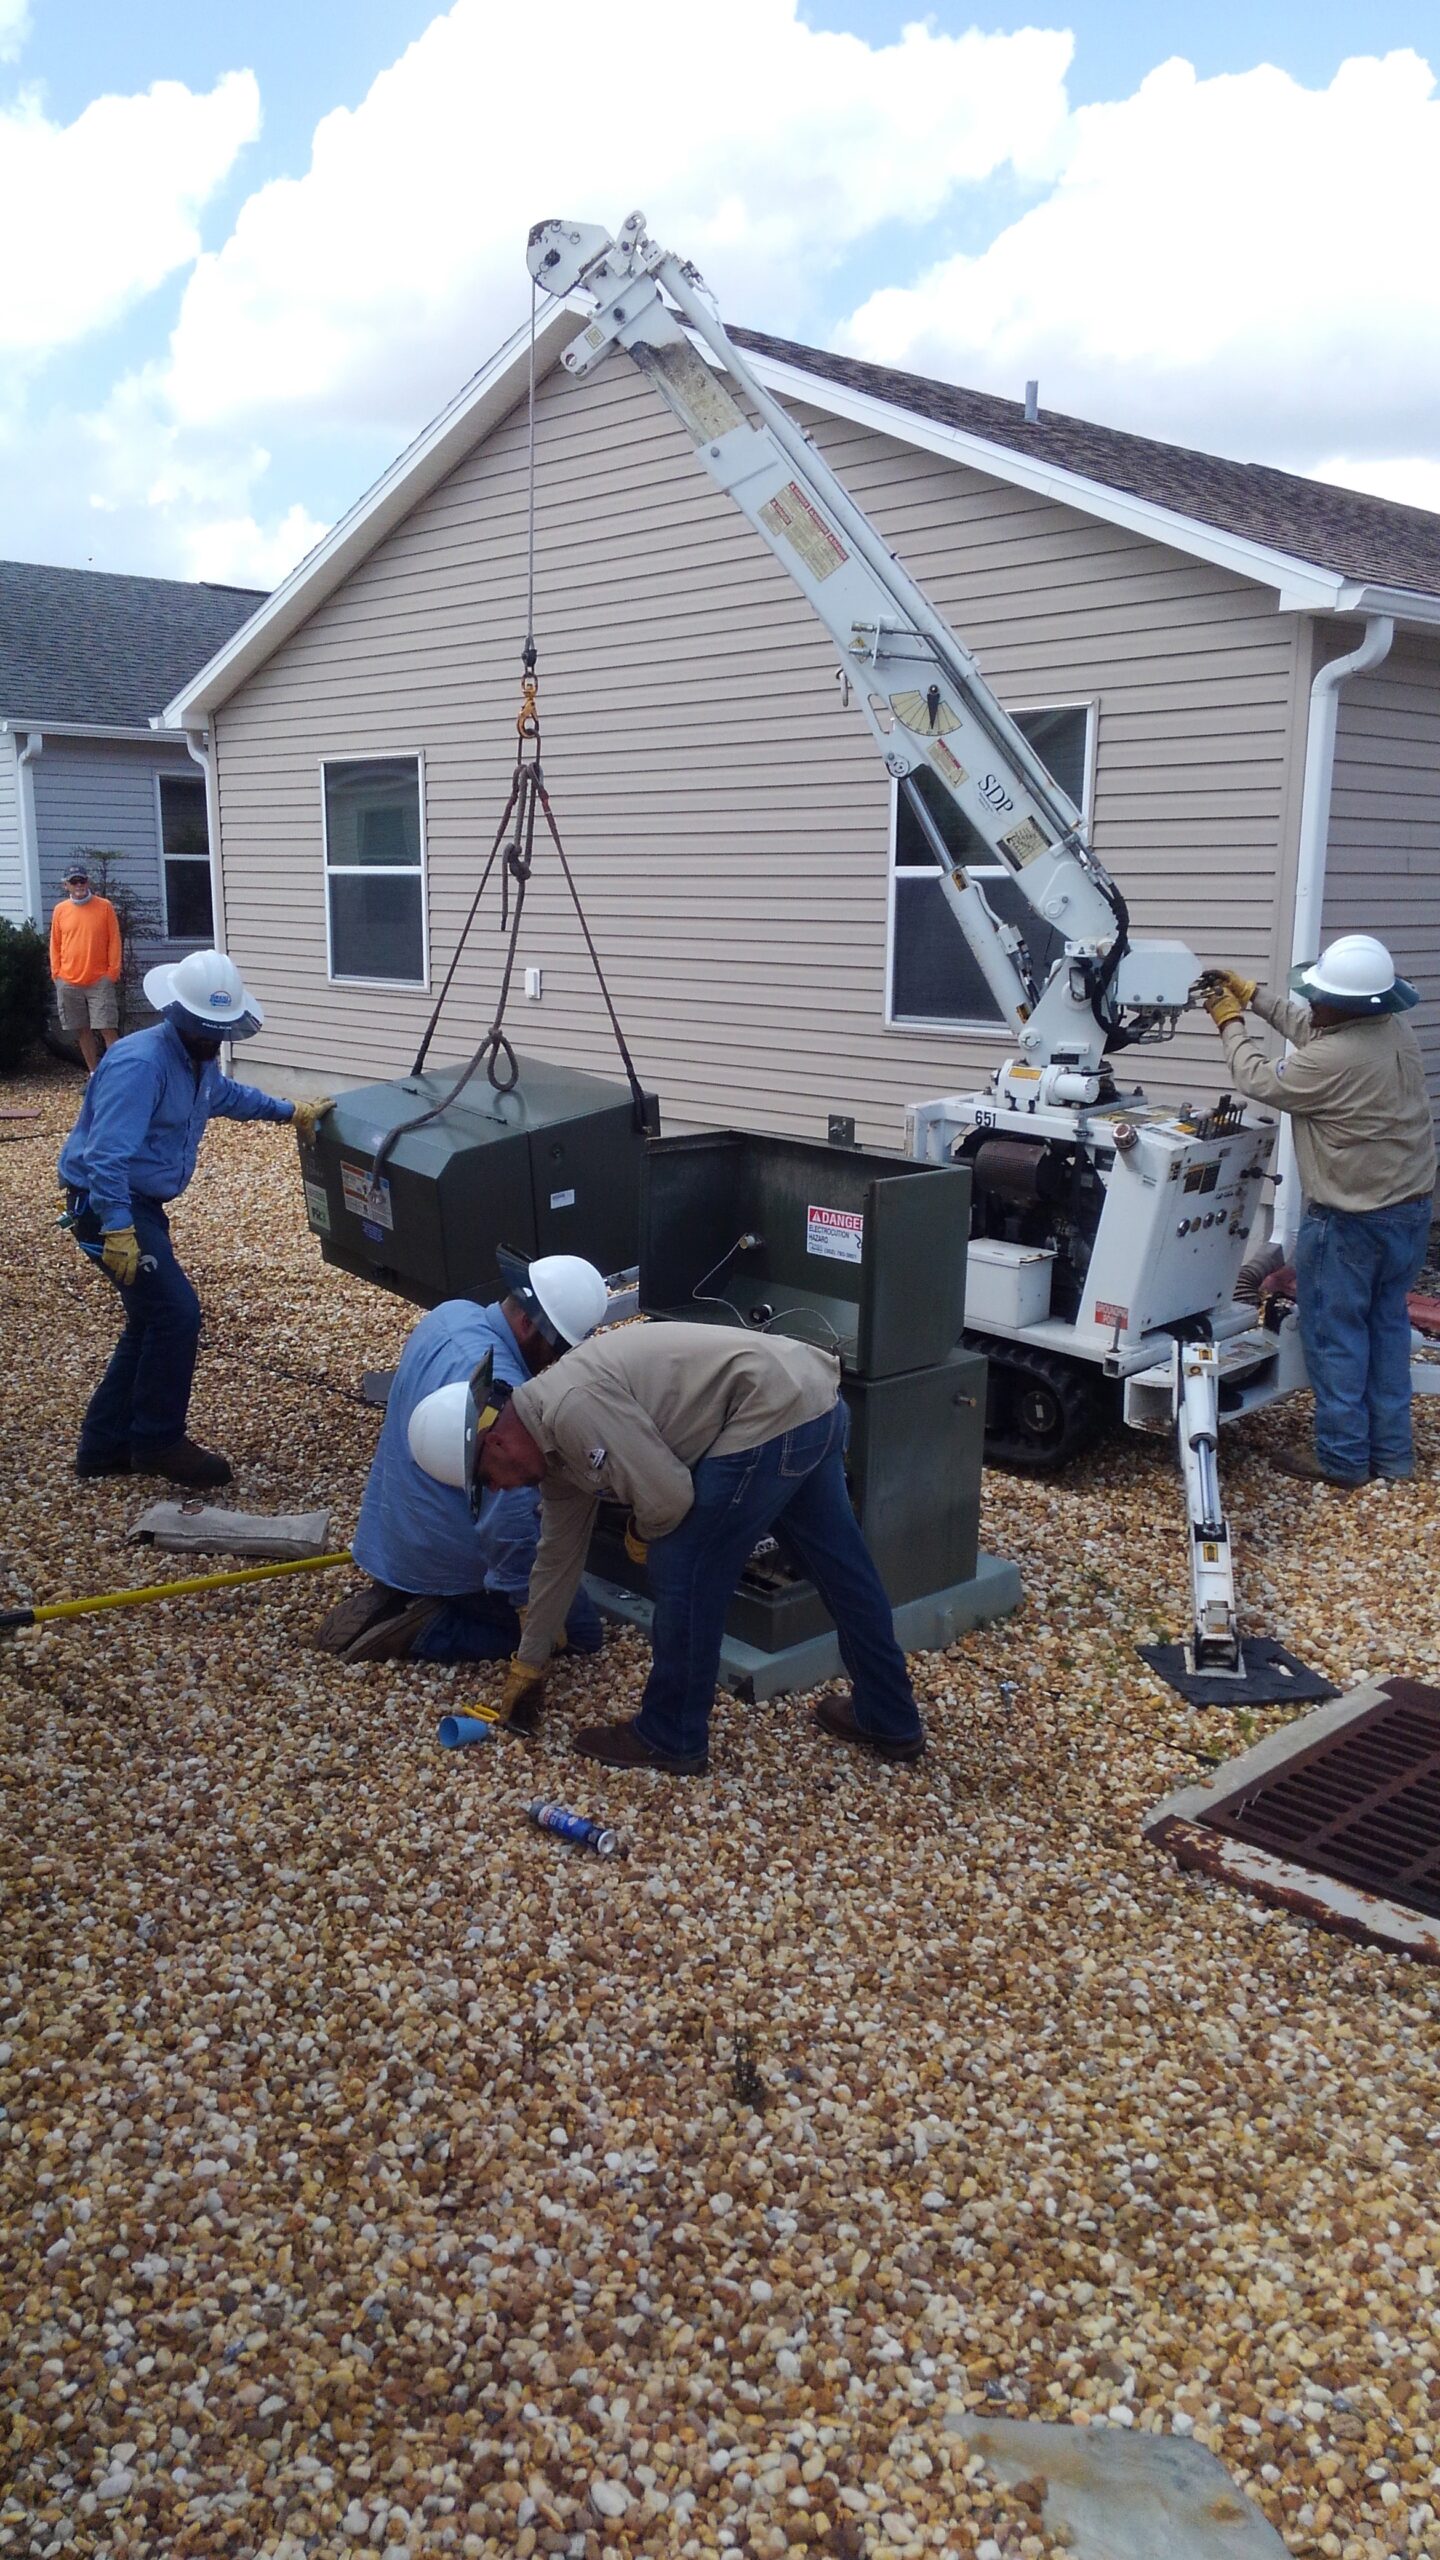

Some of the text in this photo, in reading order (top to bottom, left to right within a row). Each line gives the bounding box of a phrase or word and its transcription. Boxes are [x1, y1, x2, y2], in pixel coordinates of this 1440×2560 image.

[978, 774, 1014, 811] SDP
[975, 1110, 996, 1127] 651
[809, 1234, 828, 1244] HAZARD
